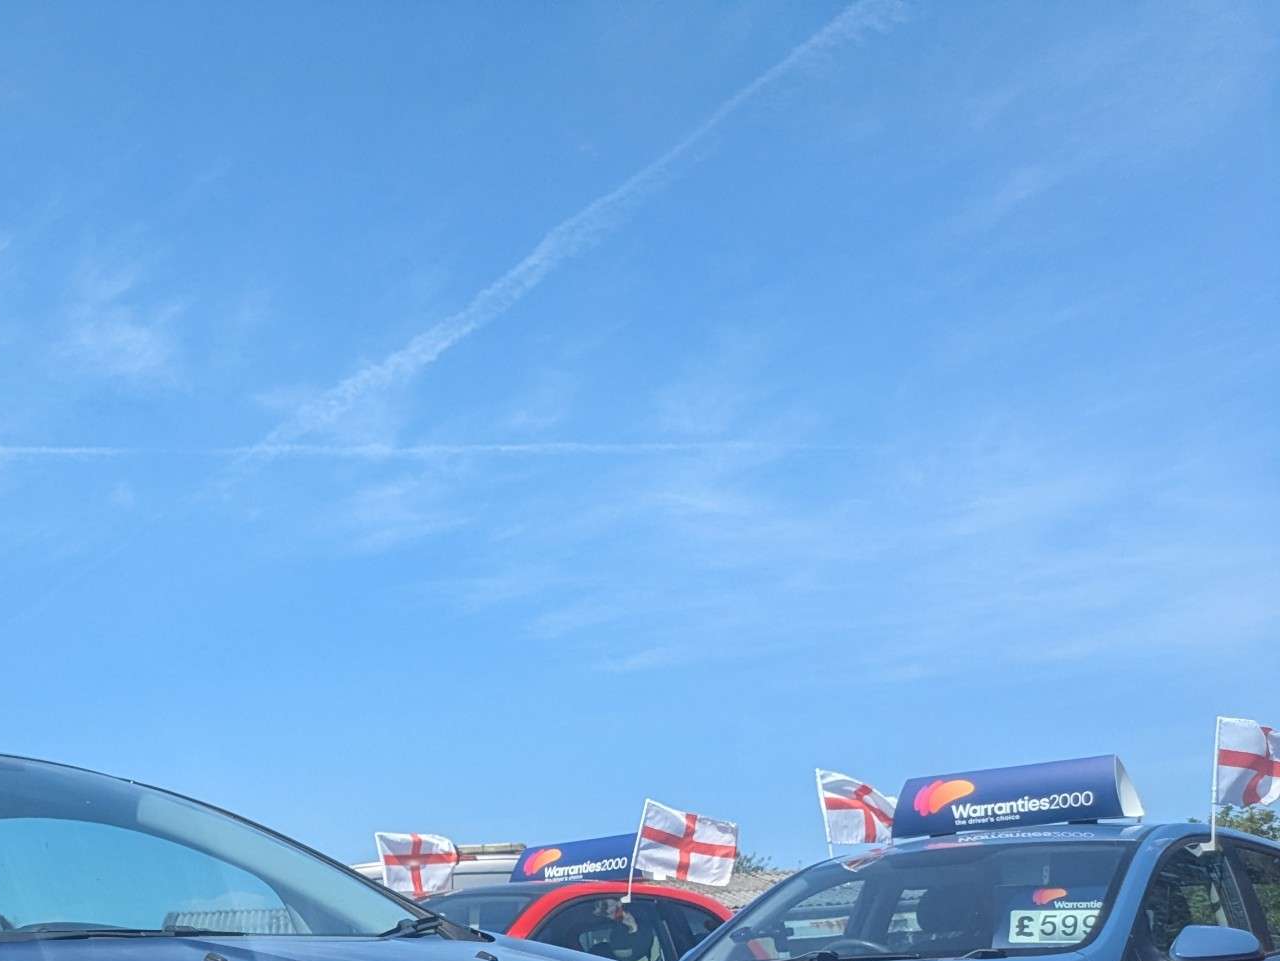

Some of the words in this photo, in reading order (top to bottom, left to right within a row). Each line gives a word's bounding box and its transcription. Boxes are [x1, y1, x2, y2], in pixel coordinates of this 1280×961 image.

[951, 790, 1094, 819] Warranties2000
[968, 816, 994, 825] driver's
[996, 814, 1020, 822] choice
[544, 857, 628, 878] Warranties2000
